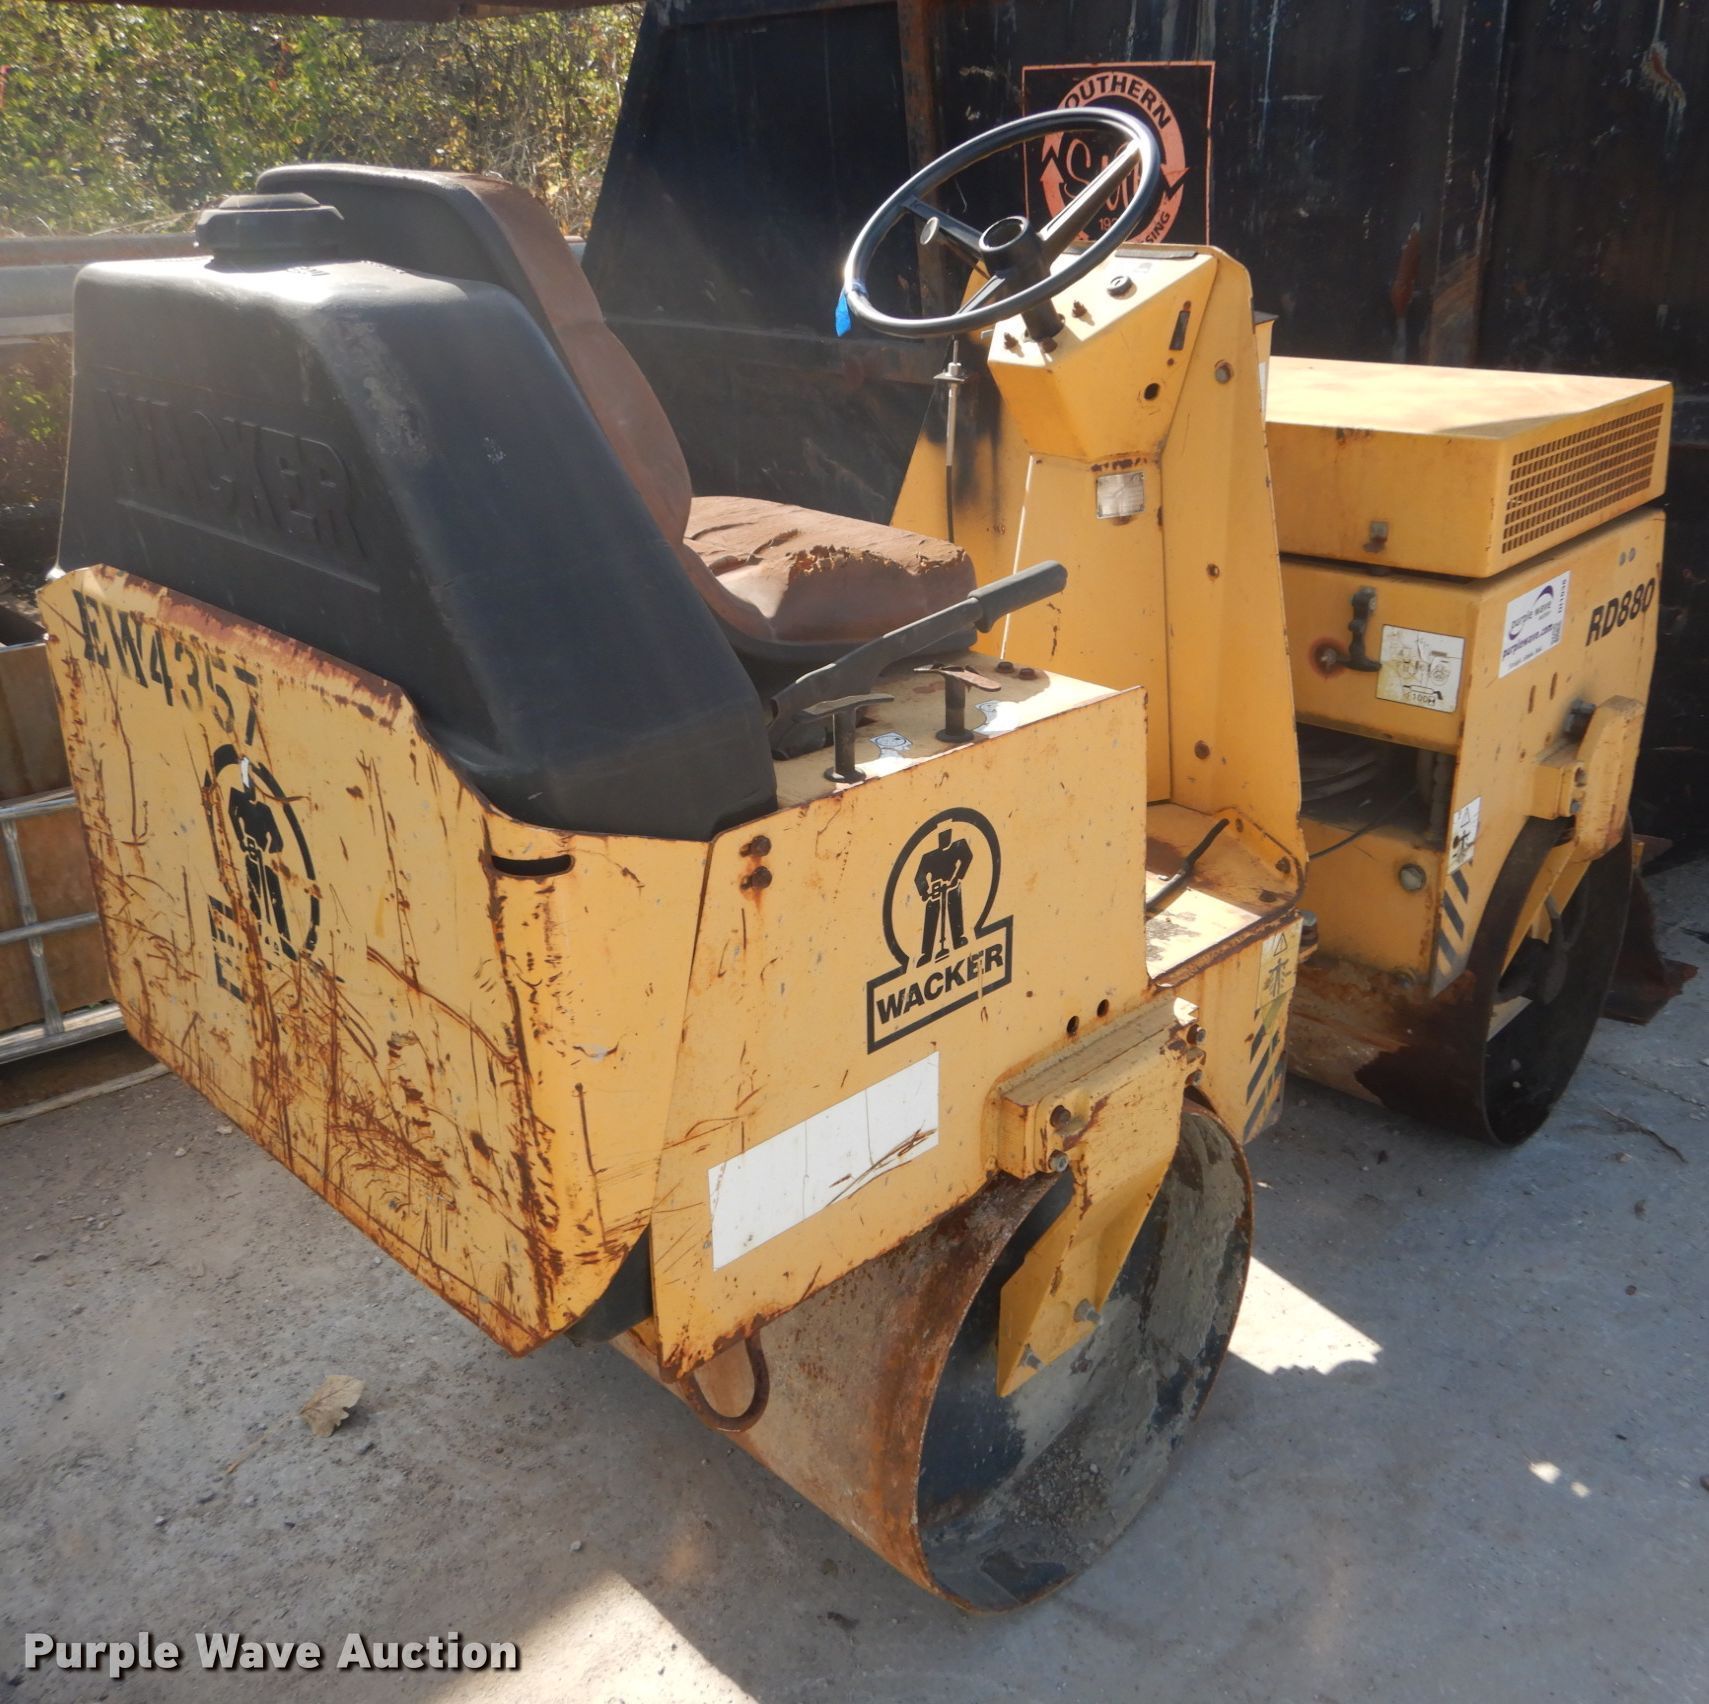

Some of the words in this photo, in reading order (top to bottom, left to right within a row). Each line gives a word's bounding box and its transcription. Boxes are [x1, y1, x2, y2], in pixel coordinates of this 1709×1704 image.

[1064, 74, 1172, 130] OUTHERN
[1585, 577, 1656, 647] RD880
[72, 589, 258, 747] EW4357
[876, 943, 1004, 1025] WACKER
